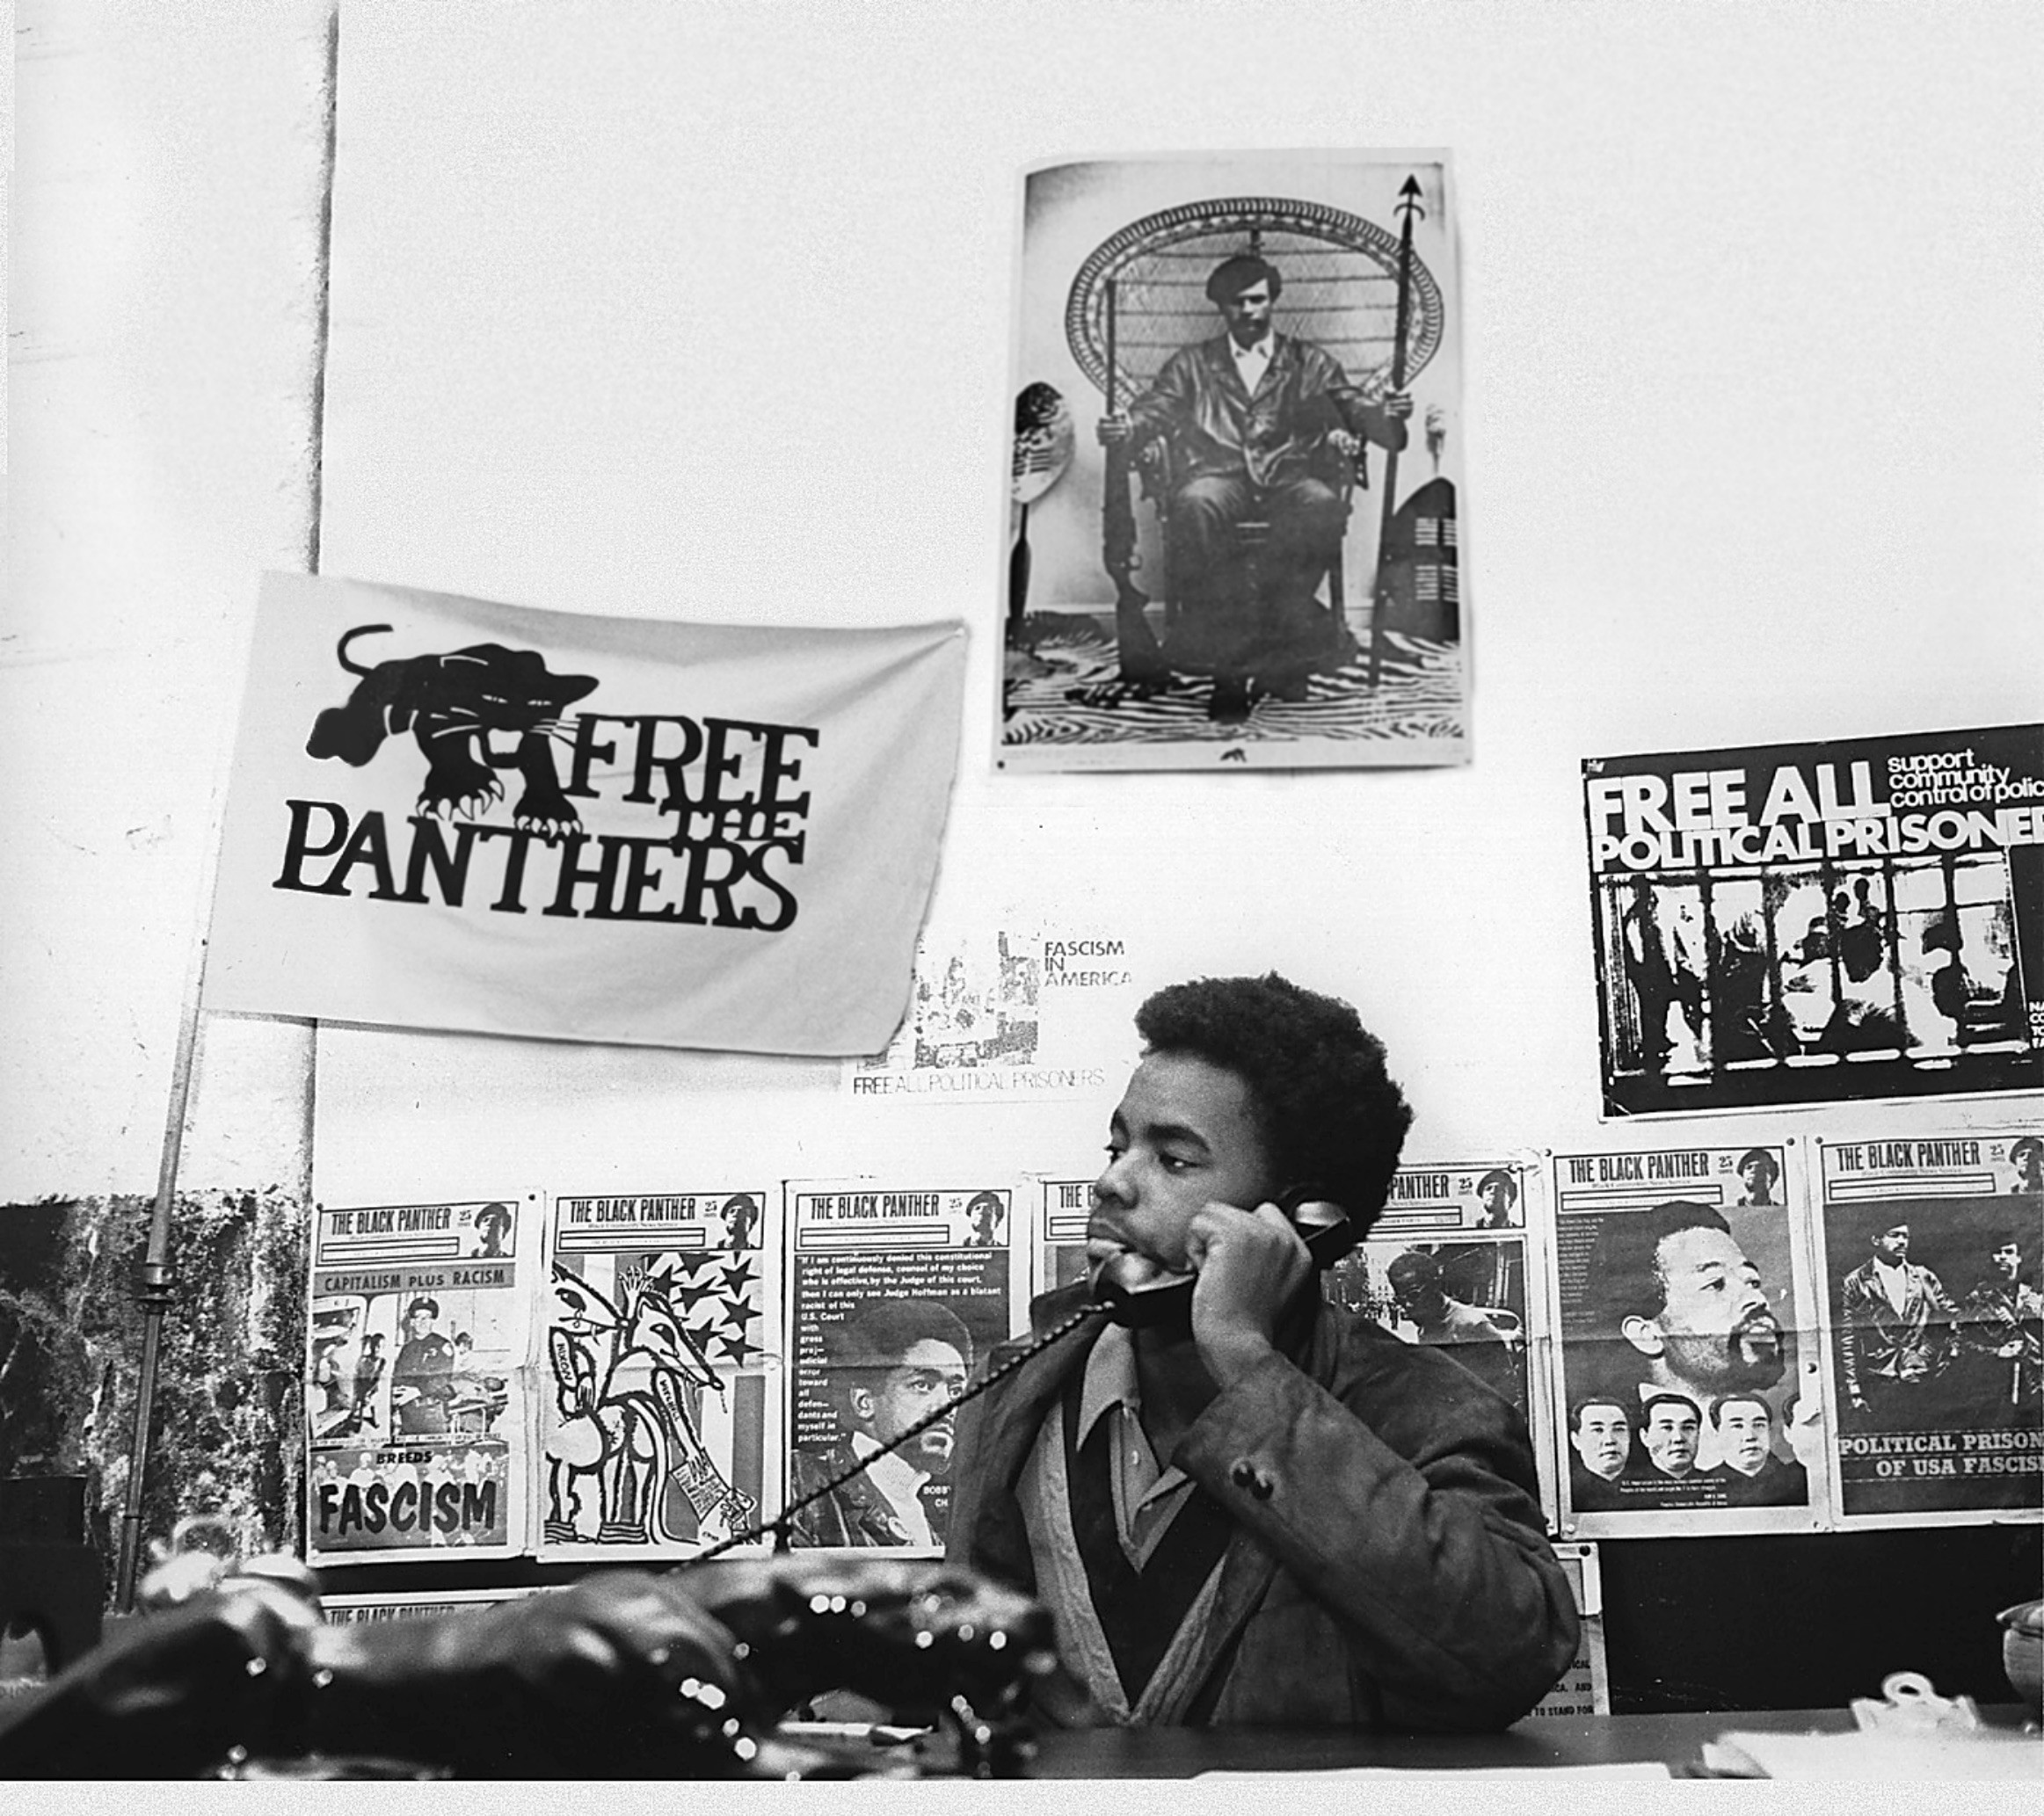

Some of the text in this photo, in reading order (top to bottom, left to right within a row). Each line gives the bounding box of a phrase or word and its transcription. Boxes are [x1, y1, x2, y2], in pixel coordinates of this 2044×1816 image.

[557, 713, 818, 808] FREE
[1888, 748, 1975, 774] support
[1889, 763, 2011, 789] community
[1588, 761, 1891, 835] FREE ALL
[1891, 784, 1968, 808] control
[1969, 785, 1992, 801] of
[658, 799, 807, 842] THE
[1593, 823, 1824, 873] POLITICAL
[272, 799, 805, 933] PANTHERS
[1044, 941, 1125, 957] FASCISM
[1044, 956, 1065, 971] IN
[1044, 970, 1132, 987] AMERICA
[853, 1068, 1106, 1094] FREE ALL POLITICAL PRISONERS
[1568, 1152, 1709, 1184] THE BLACK PANTHER
[1718, 1156, 1733, 1168] 25
[1837, 1141, 1981, 1172] THE BLACK PANTHER
[1391, 1174, 1450, 1200] PANTHER
[1458, 1178, 1473, 1189] 25
[811, 1194, 940, 1220] THE BLACK PANTHER
[1058, 1185, 1082, 1209] THE
[331, 1208, 452, 1235] THE BLACK PANTHER
[570, 1197, 695, 1224] THE BLACK PANTHER
[802, 1267, 823, 1275] right
[836, 1266, 856, 1275] legal
[957, 1262, 985, 1271] choice
[934, 1251, 992, 1261] constitutional
[324, 1269, 506, 1291] CAPITALISM PLUS RACISM
[556, 1343, 572, 1380] NIXON
[798, 1377, 828, 1386] toward
[797, 1421, 826, 1433] myself
[376, 1451, 433, 1464] BREEDS
[1838, 1435, 1957, 1455] POLITICAL
[1875, 1455, 2044, 1477] OF USA FASCIS
[319, 1480, 496, 1535] FASCISM
